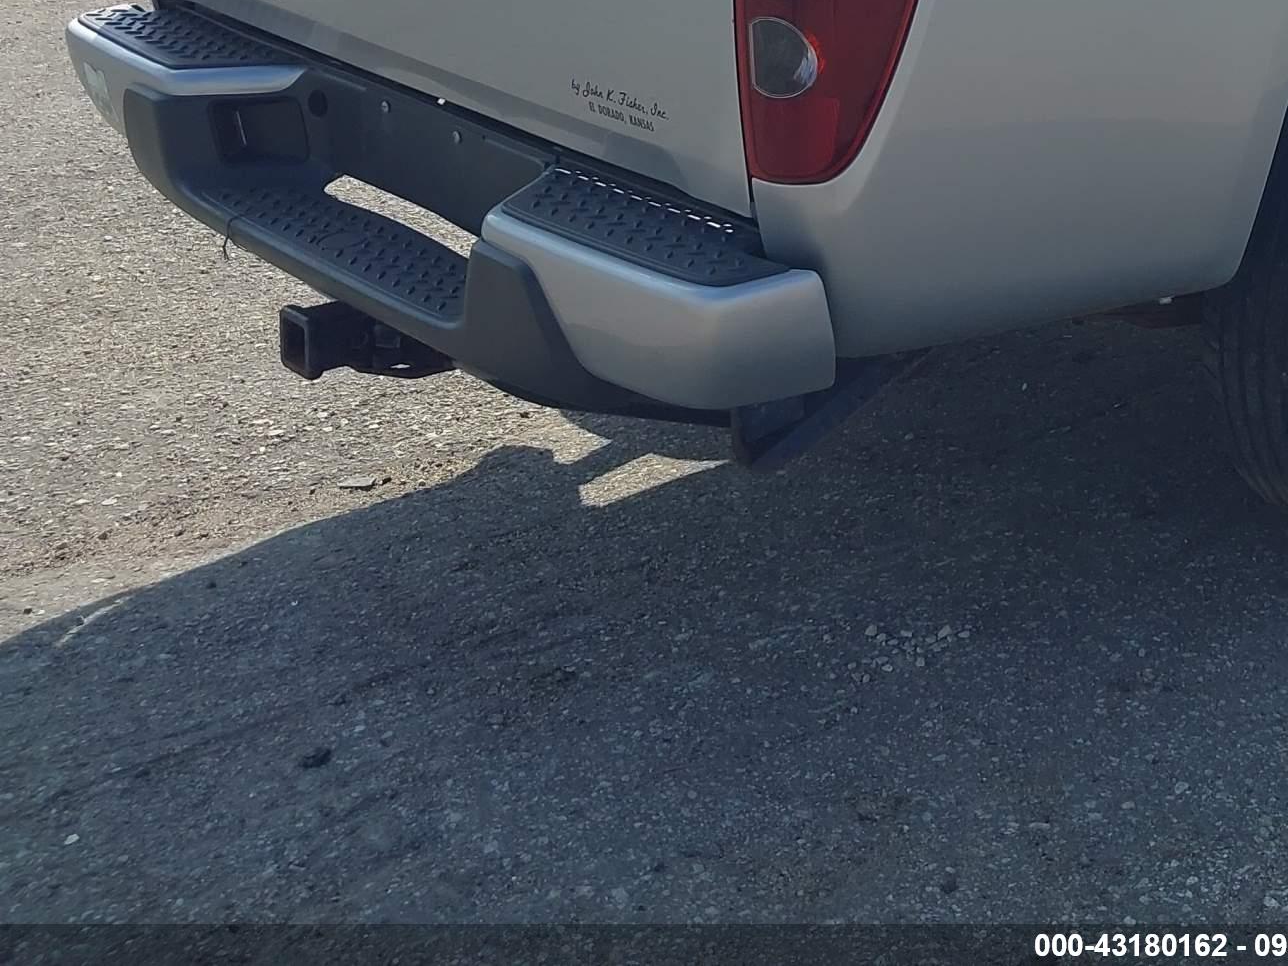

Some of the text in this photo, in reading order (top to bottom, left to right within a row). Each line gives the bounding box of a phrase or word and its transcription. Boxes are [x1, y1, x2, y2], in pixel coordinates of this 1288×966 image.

[571, 79, 580, 95] by
[583, 82, 603, 98] John
[629, 115, 655, 132] KANSAS
